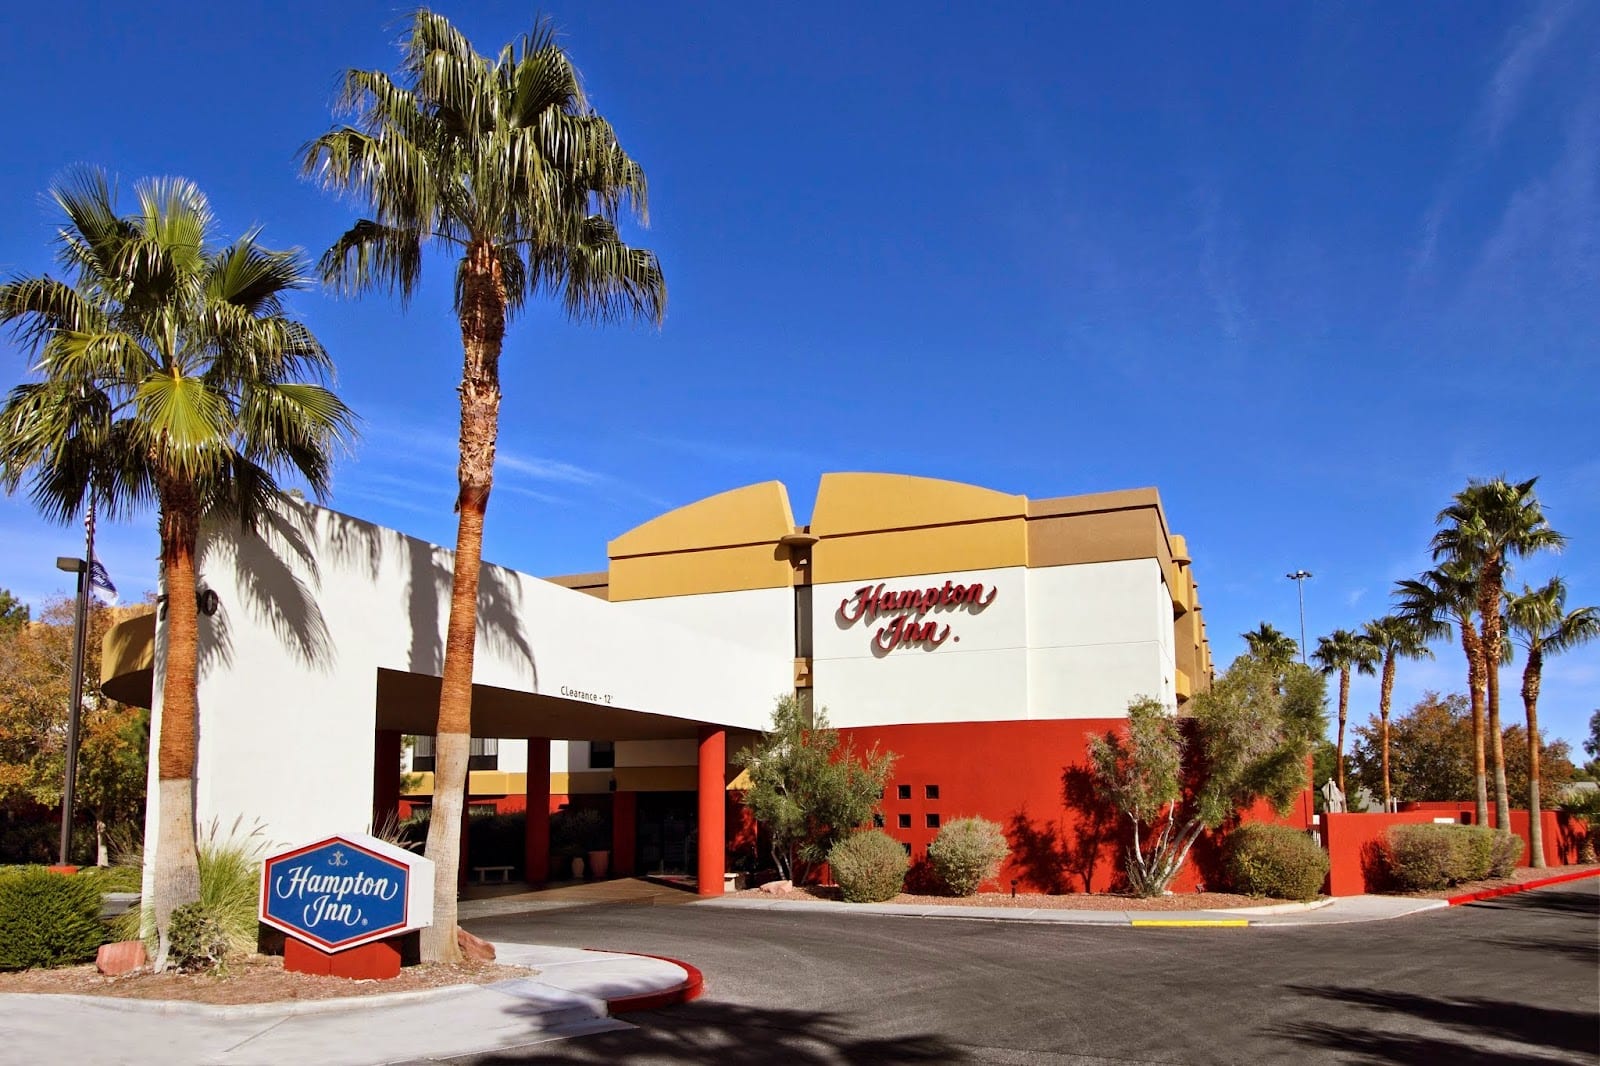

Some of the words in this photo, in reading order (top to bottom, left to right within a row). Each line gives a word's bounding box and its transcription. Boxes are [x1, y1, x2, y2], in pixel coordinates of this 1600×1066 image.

[840, 580, 997, 621] Hampton
[876, 615, 950, 650] Inn
[276, 866, 398, 901] Hampton
